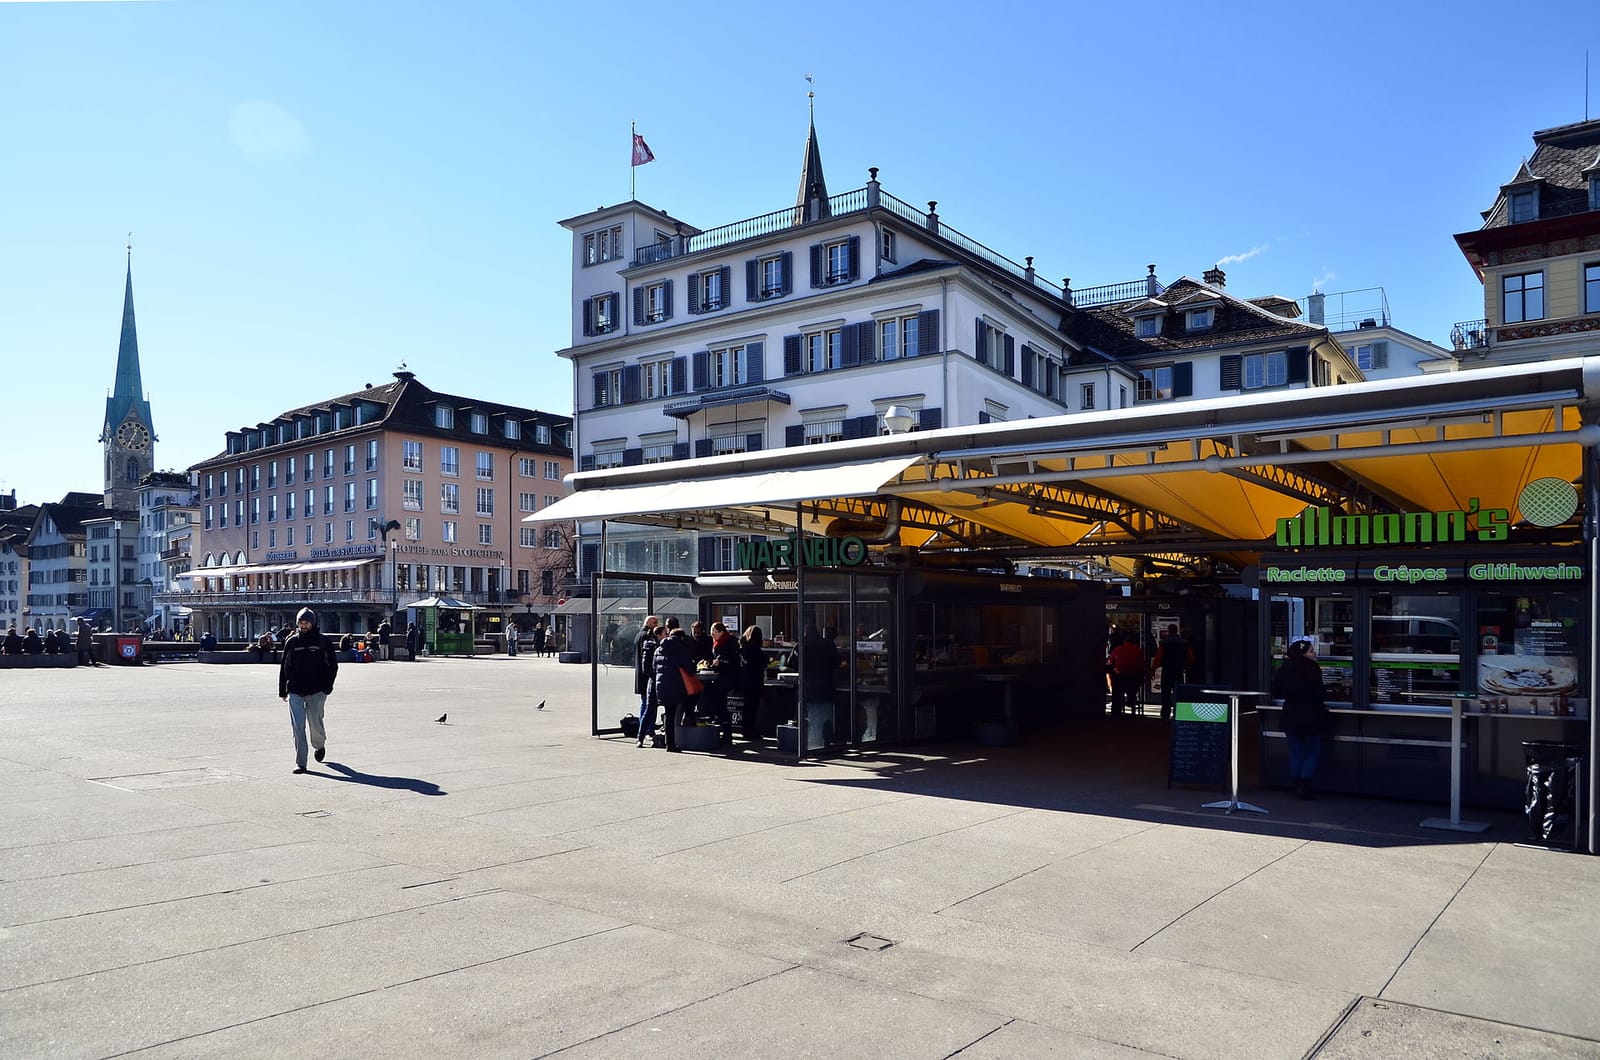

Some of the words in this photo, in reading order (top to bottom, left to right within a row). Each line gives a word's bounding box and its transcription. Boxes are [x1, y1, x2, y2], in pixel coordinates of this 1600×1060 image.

[1275, 498, 1510, 547] allmann's
[451, 548, 503, 559] STORCHEN
[737, 532, 866, 570] MARINELLO
[1266, 566, 1346, 582] Raclette
[1373, 565, 1448, 583] Crêpes
[1469, 562, 1582, 580] Glühwein
